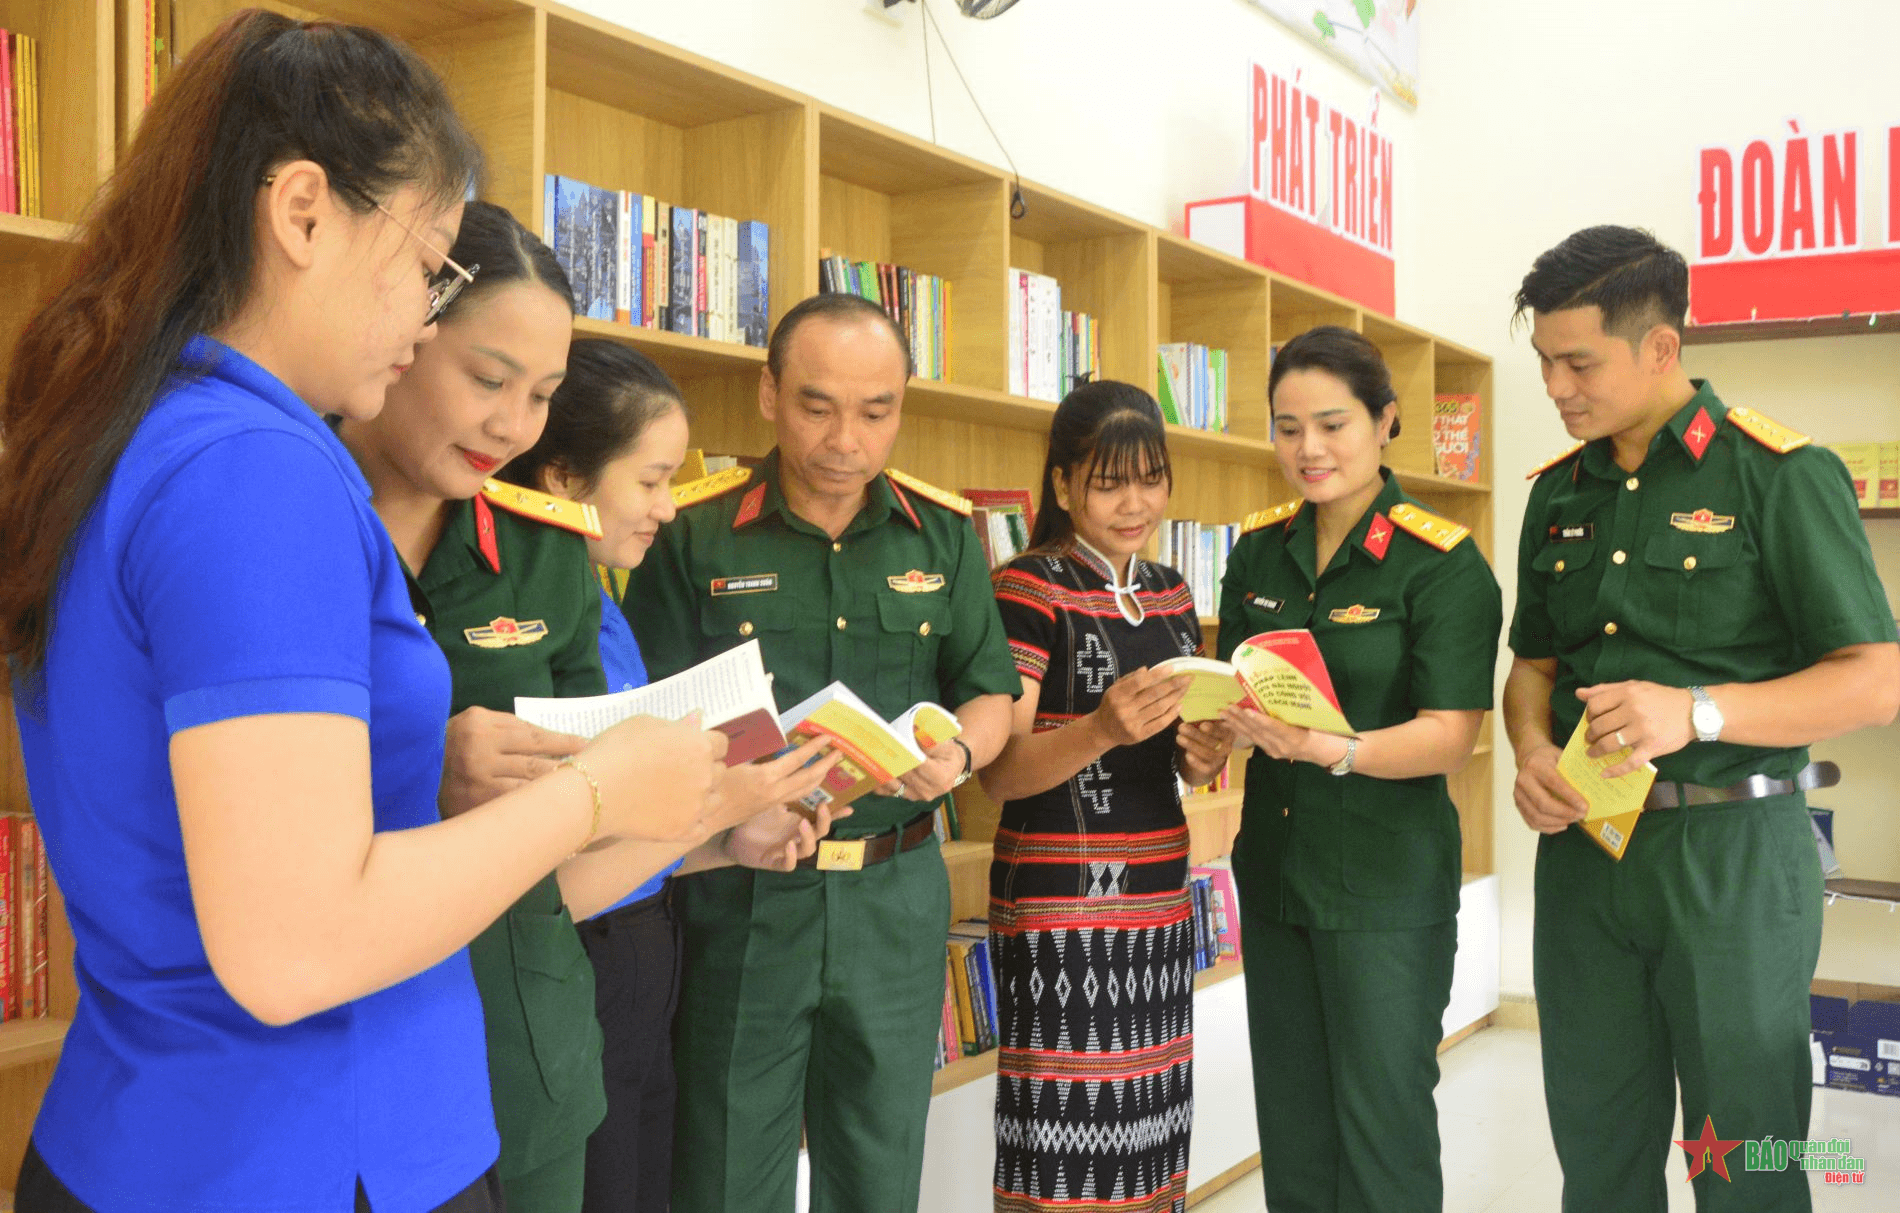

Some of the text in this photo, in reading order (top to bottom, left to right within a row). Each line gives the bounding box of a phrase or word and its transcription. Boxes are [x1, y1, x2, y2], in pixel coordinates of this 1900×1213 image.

[1253, 63, 1393, 252] PHÁT TRIỂN
[1698, 119, 1857, 259] ĐOÀN
